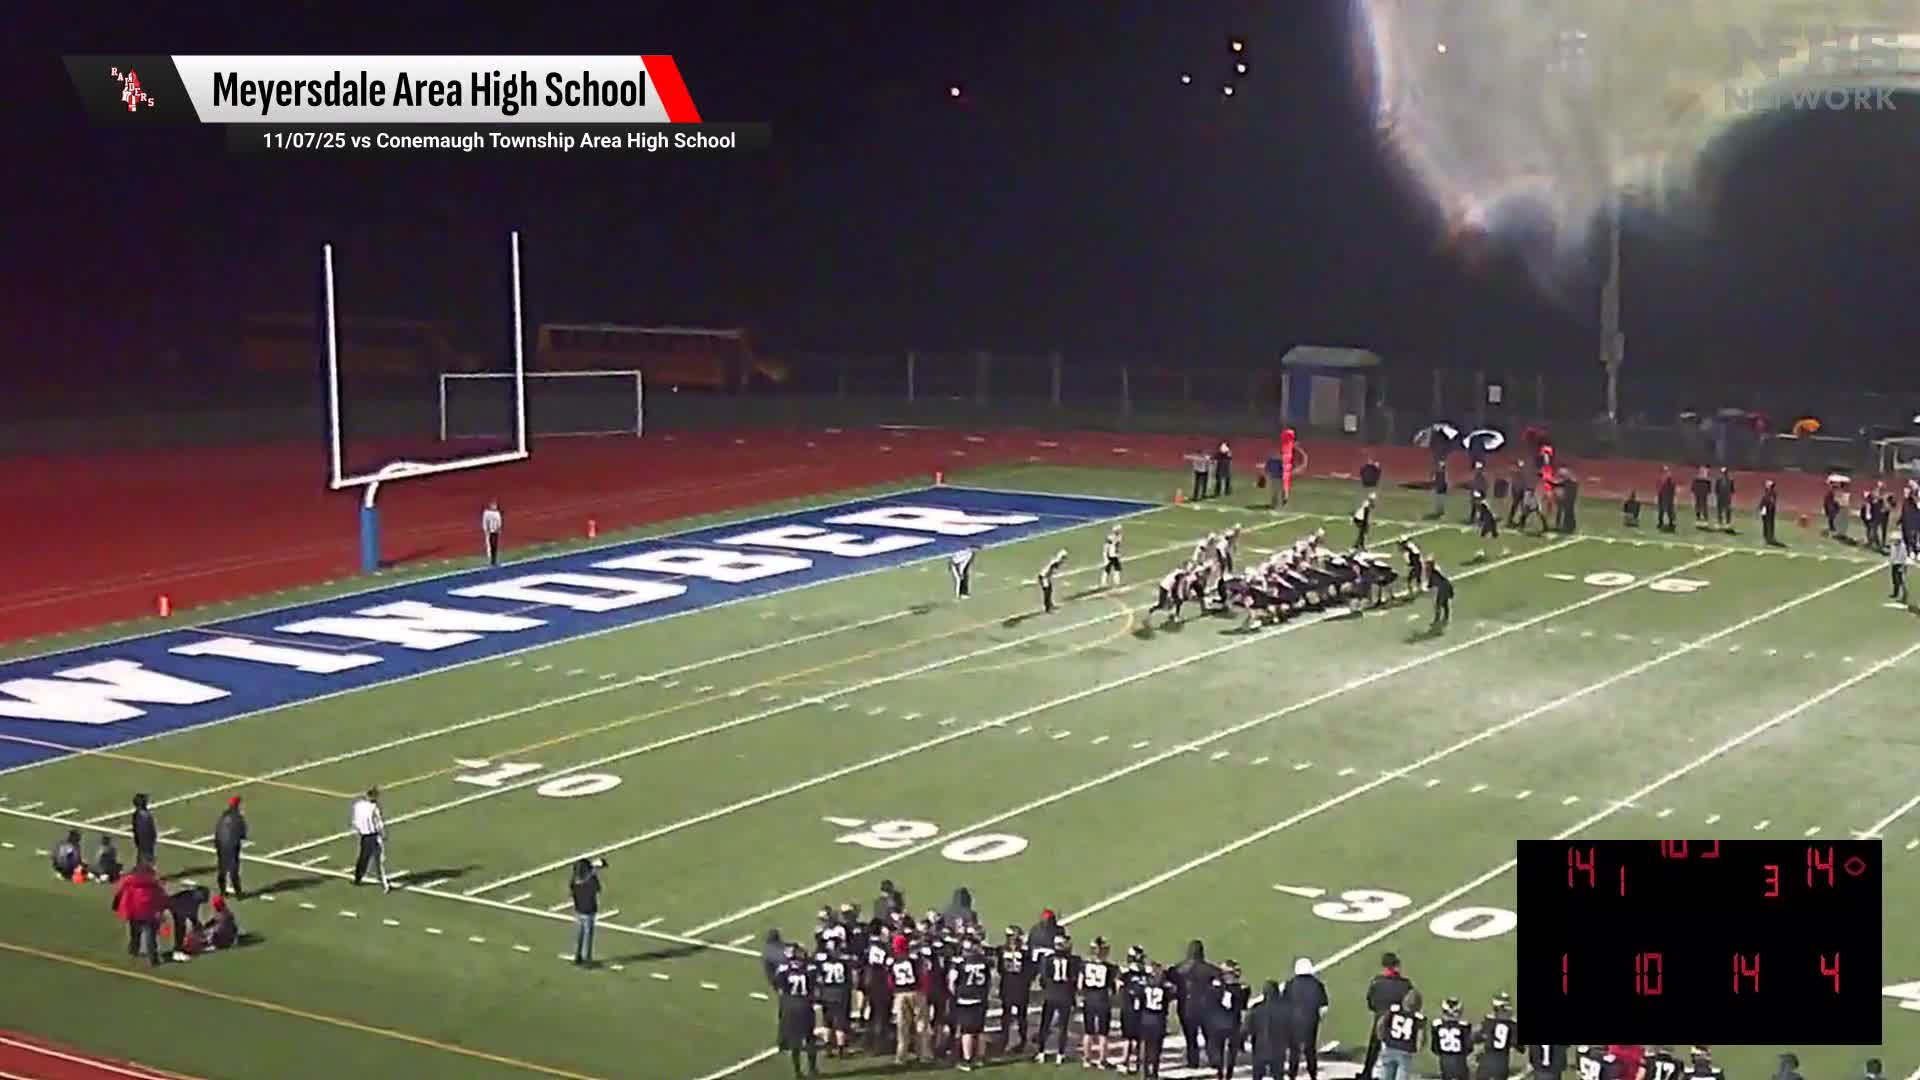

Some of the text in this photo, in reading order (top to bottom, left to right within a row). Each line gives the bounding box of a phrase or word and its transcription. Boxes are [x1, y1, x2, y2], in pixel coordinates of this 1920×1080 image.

[0, 504, 1039, 724] WINDBER
[964, 962, 986, 986] 75
[1053, 957, 1069, 982] 11
[1144, 986, 1163, 1011] 12
[1390, 1014, 1414, 1041] 54
[1438, 1027, 1462, 1052] 26
[1493, 1023, 1509, 1049] 9
